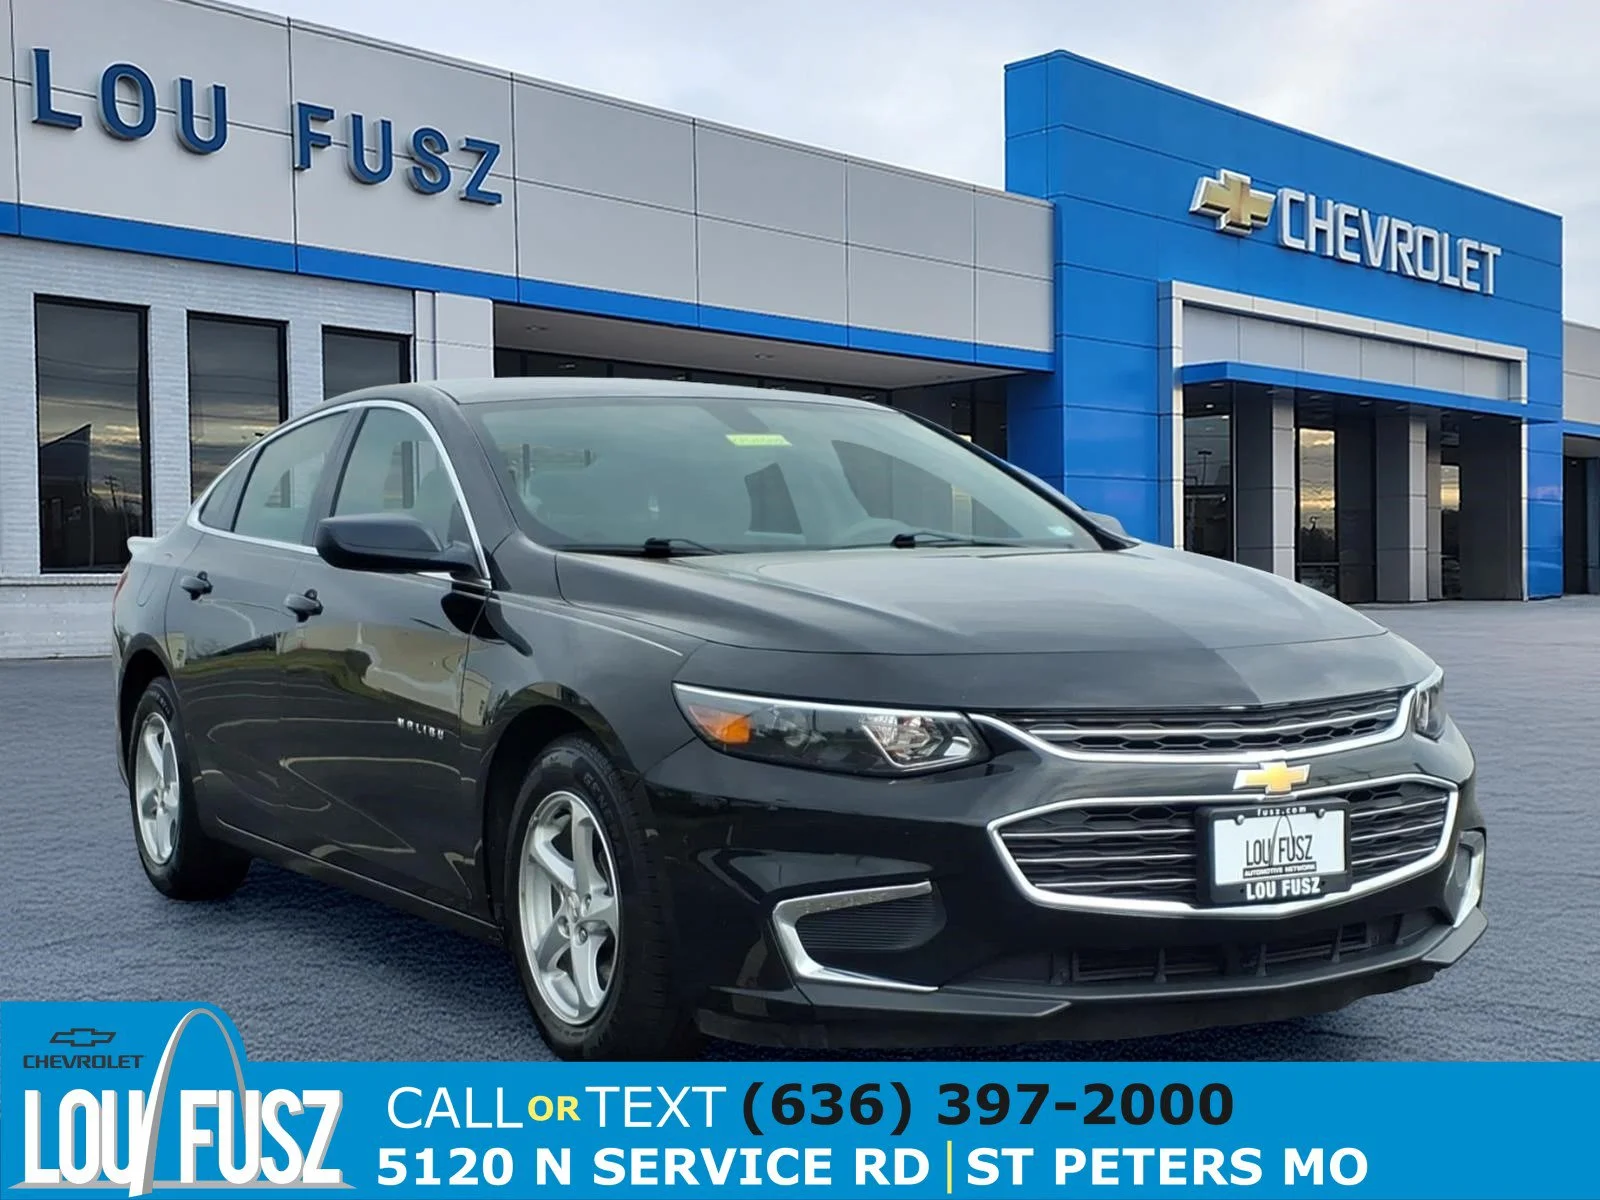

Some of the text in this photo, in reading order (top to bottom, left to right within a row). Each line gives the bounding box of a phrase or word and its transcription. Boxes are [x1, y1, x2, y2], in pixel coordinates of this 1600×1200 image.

[31, 47, 503, 206] LOU FUSZ
[1277, 187, 1502, 296] CHEVROLET
[397, 717, 445, 740] MALIBU
[1257, 806, 1307, 817] fusz.com
[1246, 835, 1313, 866] LOU FUSZ
[1246, 877, 1321, 900] LOU FUSZ
